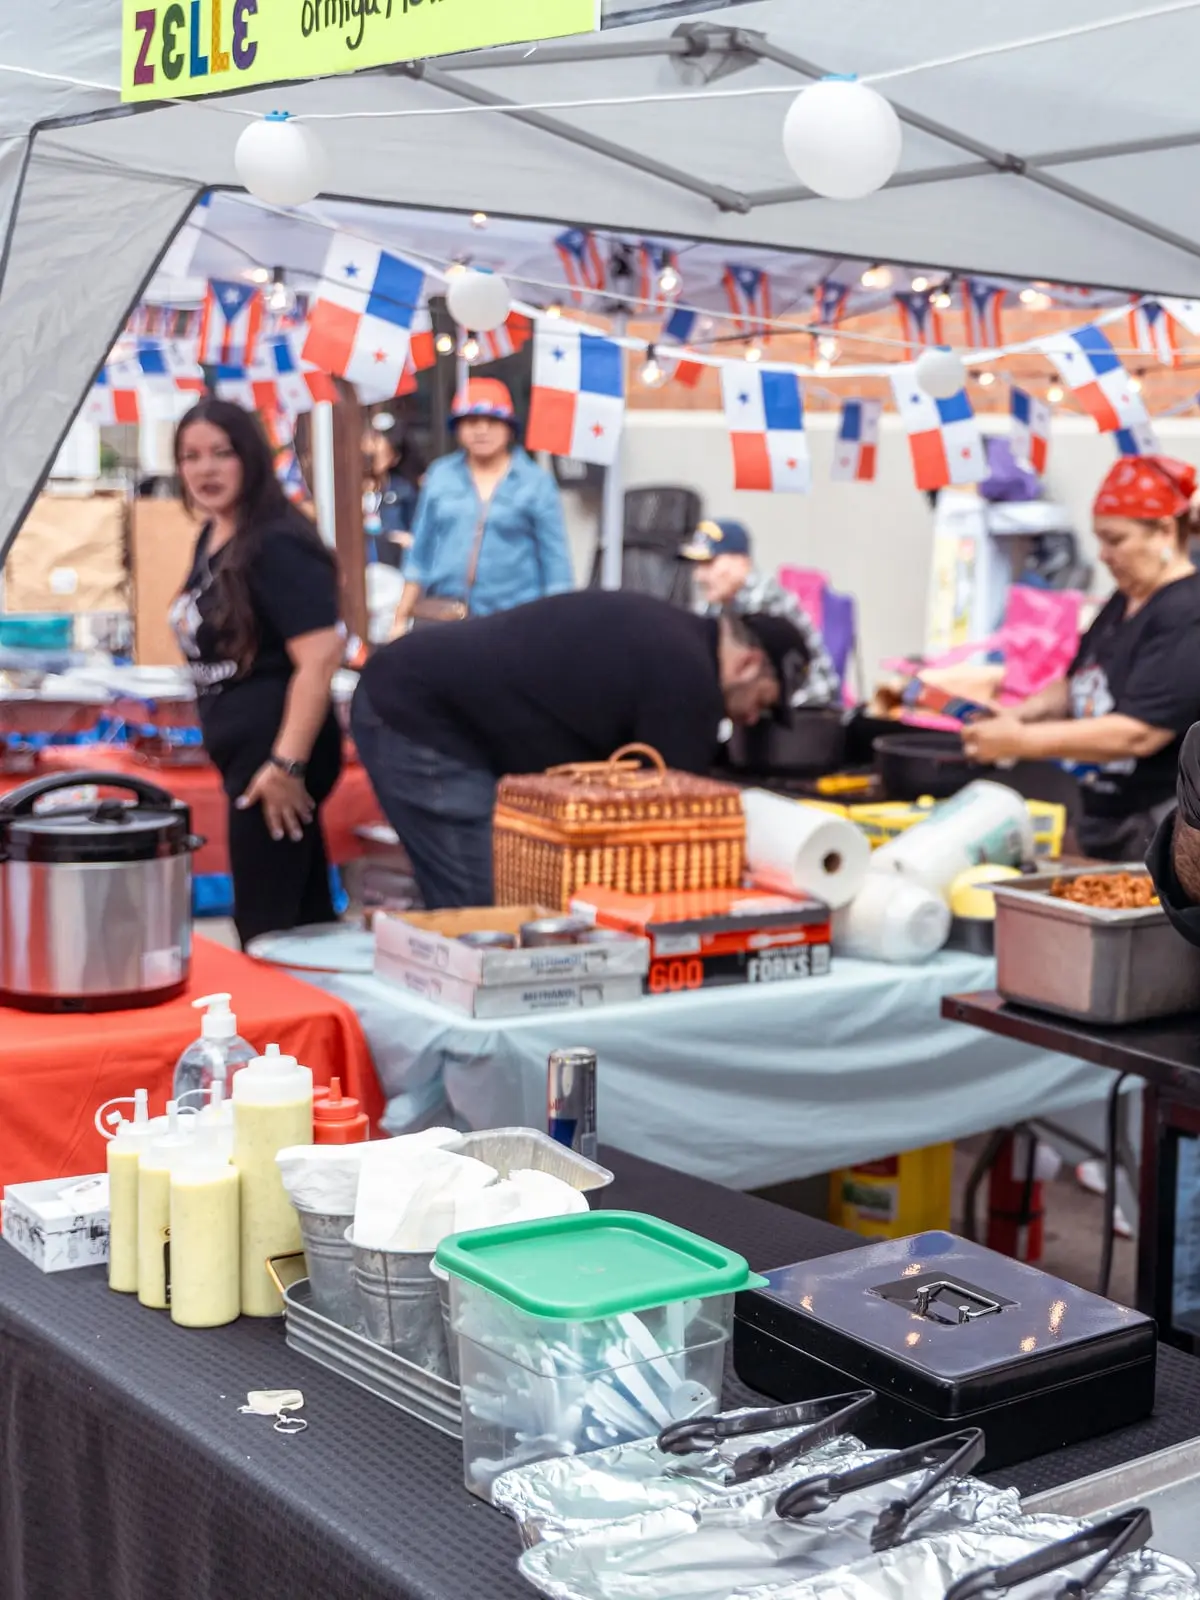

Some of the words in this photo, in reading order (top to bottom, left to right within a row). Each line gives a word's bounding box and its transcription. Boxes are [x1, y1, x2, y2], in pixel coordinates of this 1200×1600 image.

[133, 0, 258, 86] ZELLE
[650, 958, 703, 994] 600
[747, 953, 810, 983] FORKS
